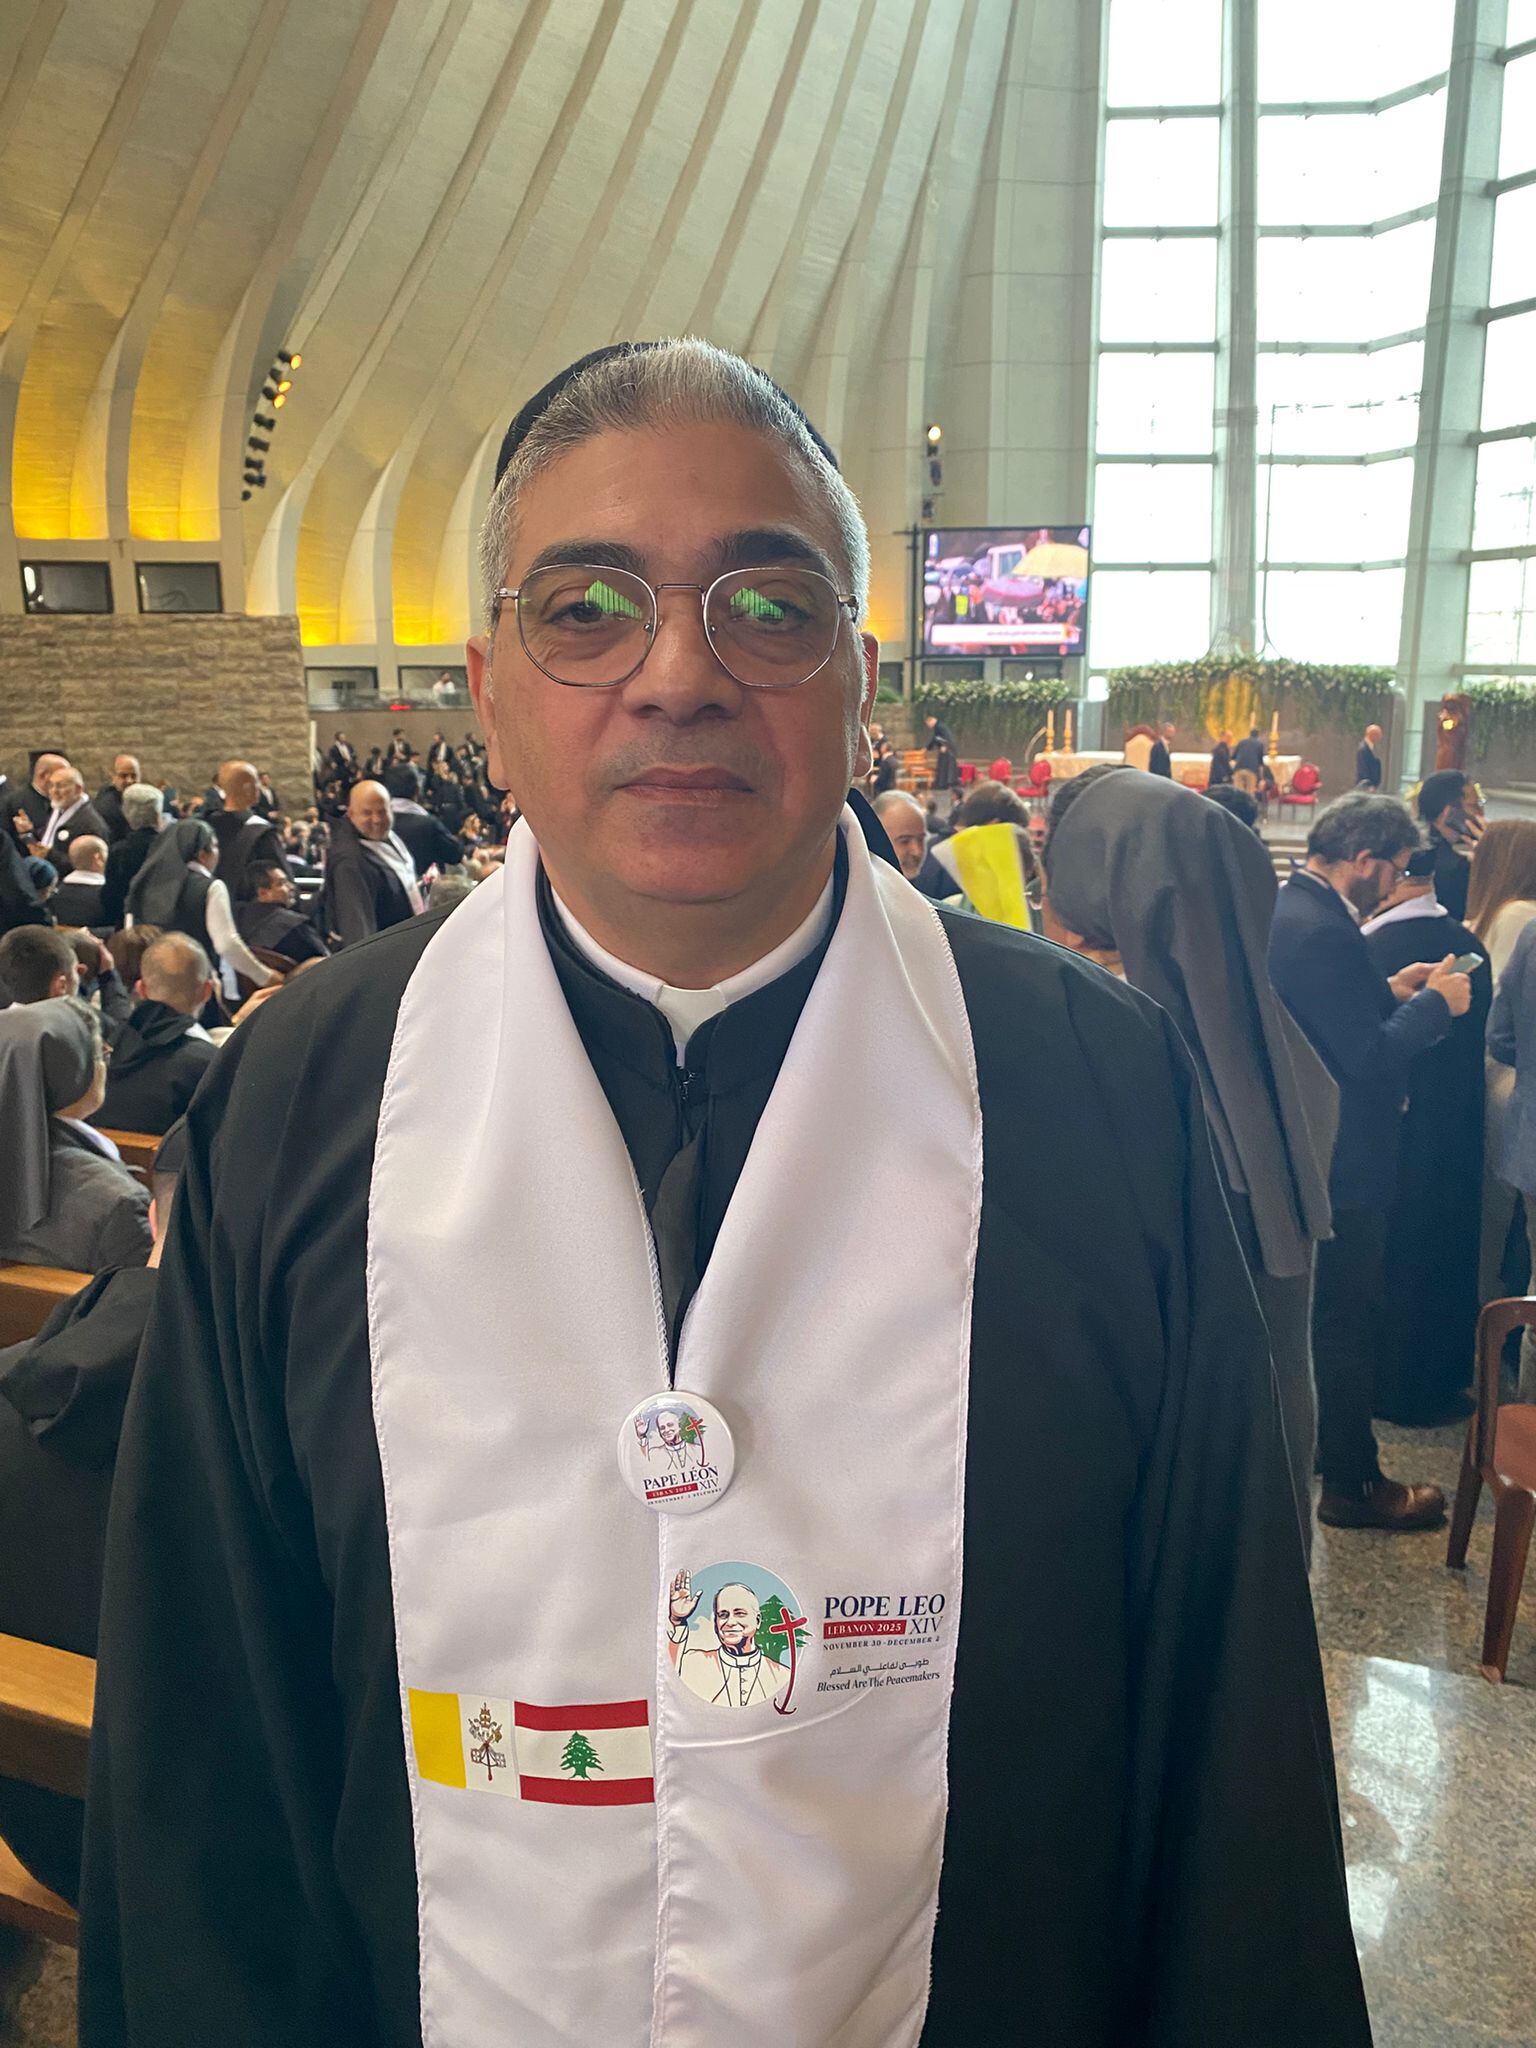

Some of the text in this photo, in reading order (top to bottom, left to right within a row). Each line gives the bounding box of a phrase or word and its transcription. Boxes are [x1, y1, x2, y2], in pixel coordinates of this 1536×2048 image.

[643, 1466, 718, 1490] PAPE LÉON
[699, 1478, 719, 1490] XIV
[824, 1593, 946, 1619] POPE LEO
[827, 1623, 901, 1635] LEBANON 2025
[909, 1616, 943, 1635] XIV
[823, 1640, 869, 1651] NOVEMBER
[887, 1637, 932, 1646] DECEMBER
[829, 1664, 862, 1678] السلام
[899, 1658, 930, 1670] طوبى
[817, 1671, 941, 1692] Blessed Are The Peacemakers
